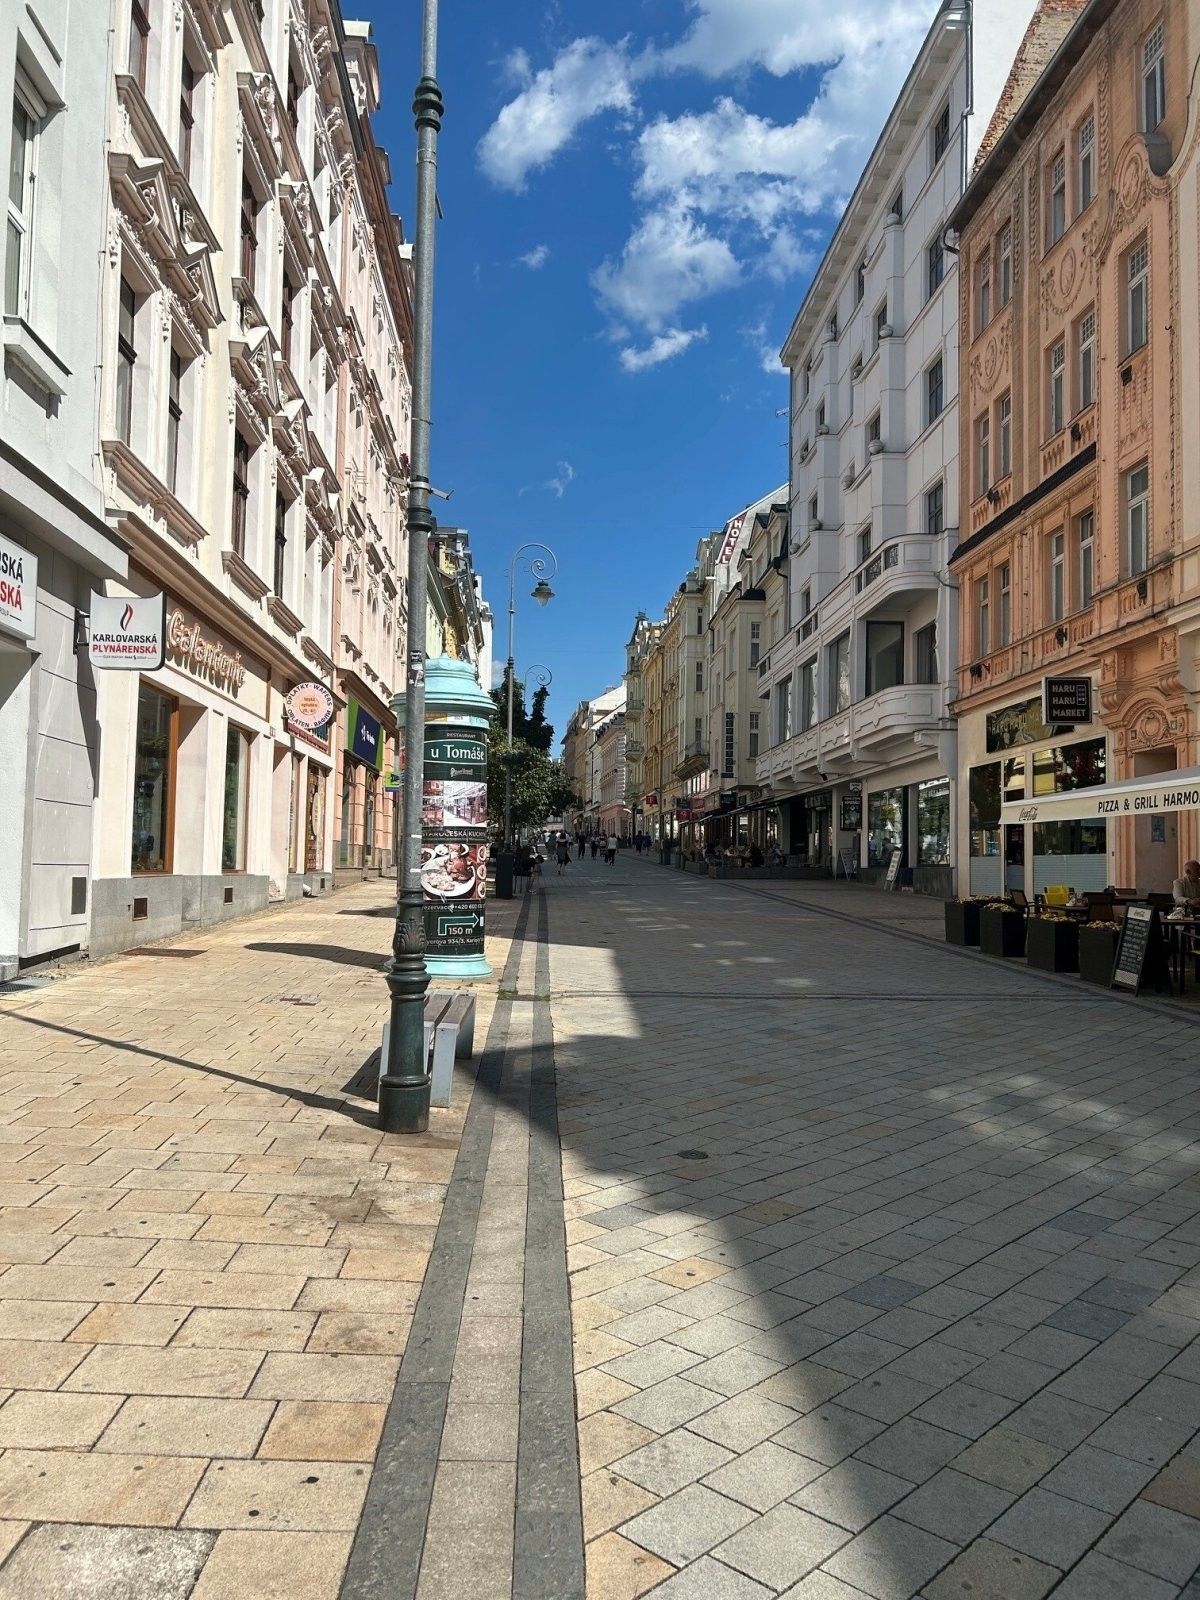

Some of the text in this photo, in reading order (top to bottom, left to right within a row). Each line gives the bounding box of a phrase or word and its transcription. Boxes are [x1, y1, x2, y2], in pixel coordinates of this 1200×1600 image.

[722, 520, 742, 563] HOTEL
[92, 633, 158, 644] KARLOVARSKÁ
[92, 643, 158, 654] PLYNÁRENSKÁ
[287, 683, 332, 706] OPLATKY WAFERS
[1052, 684, 1075, 692] HARU
[288, 709, 310, 727] OBLATEN
[1052, 709, 1086, 717] MARKET
[430, 744, 485, 760] u Tomáše
[1098, 790, 1200, 813] PIZZA & GRILL HARMO
[448, 927, 463, 935] 150
